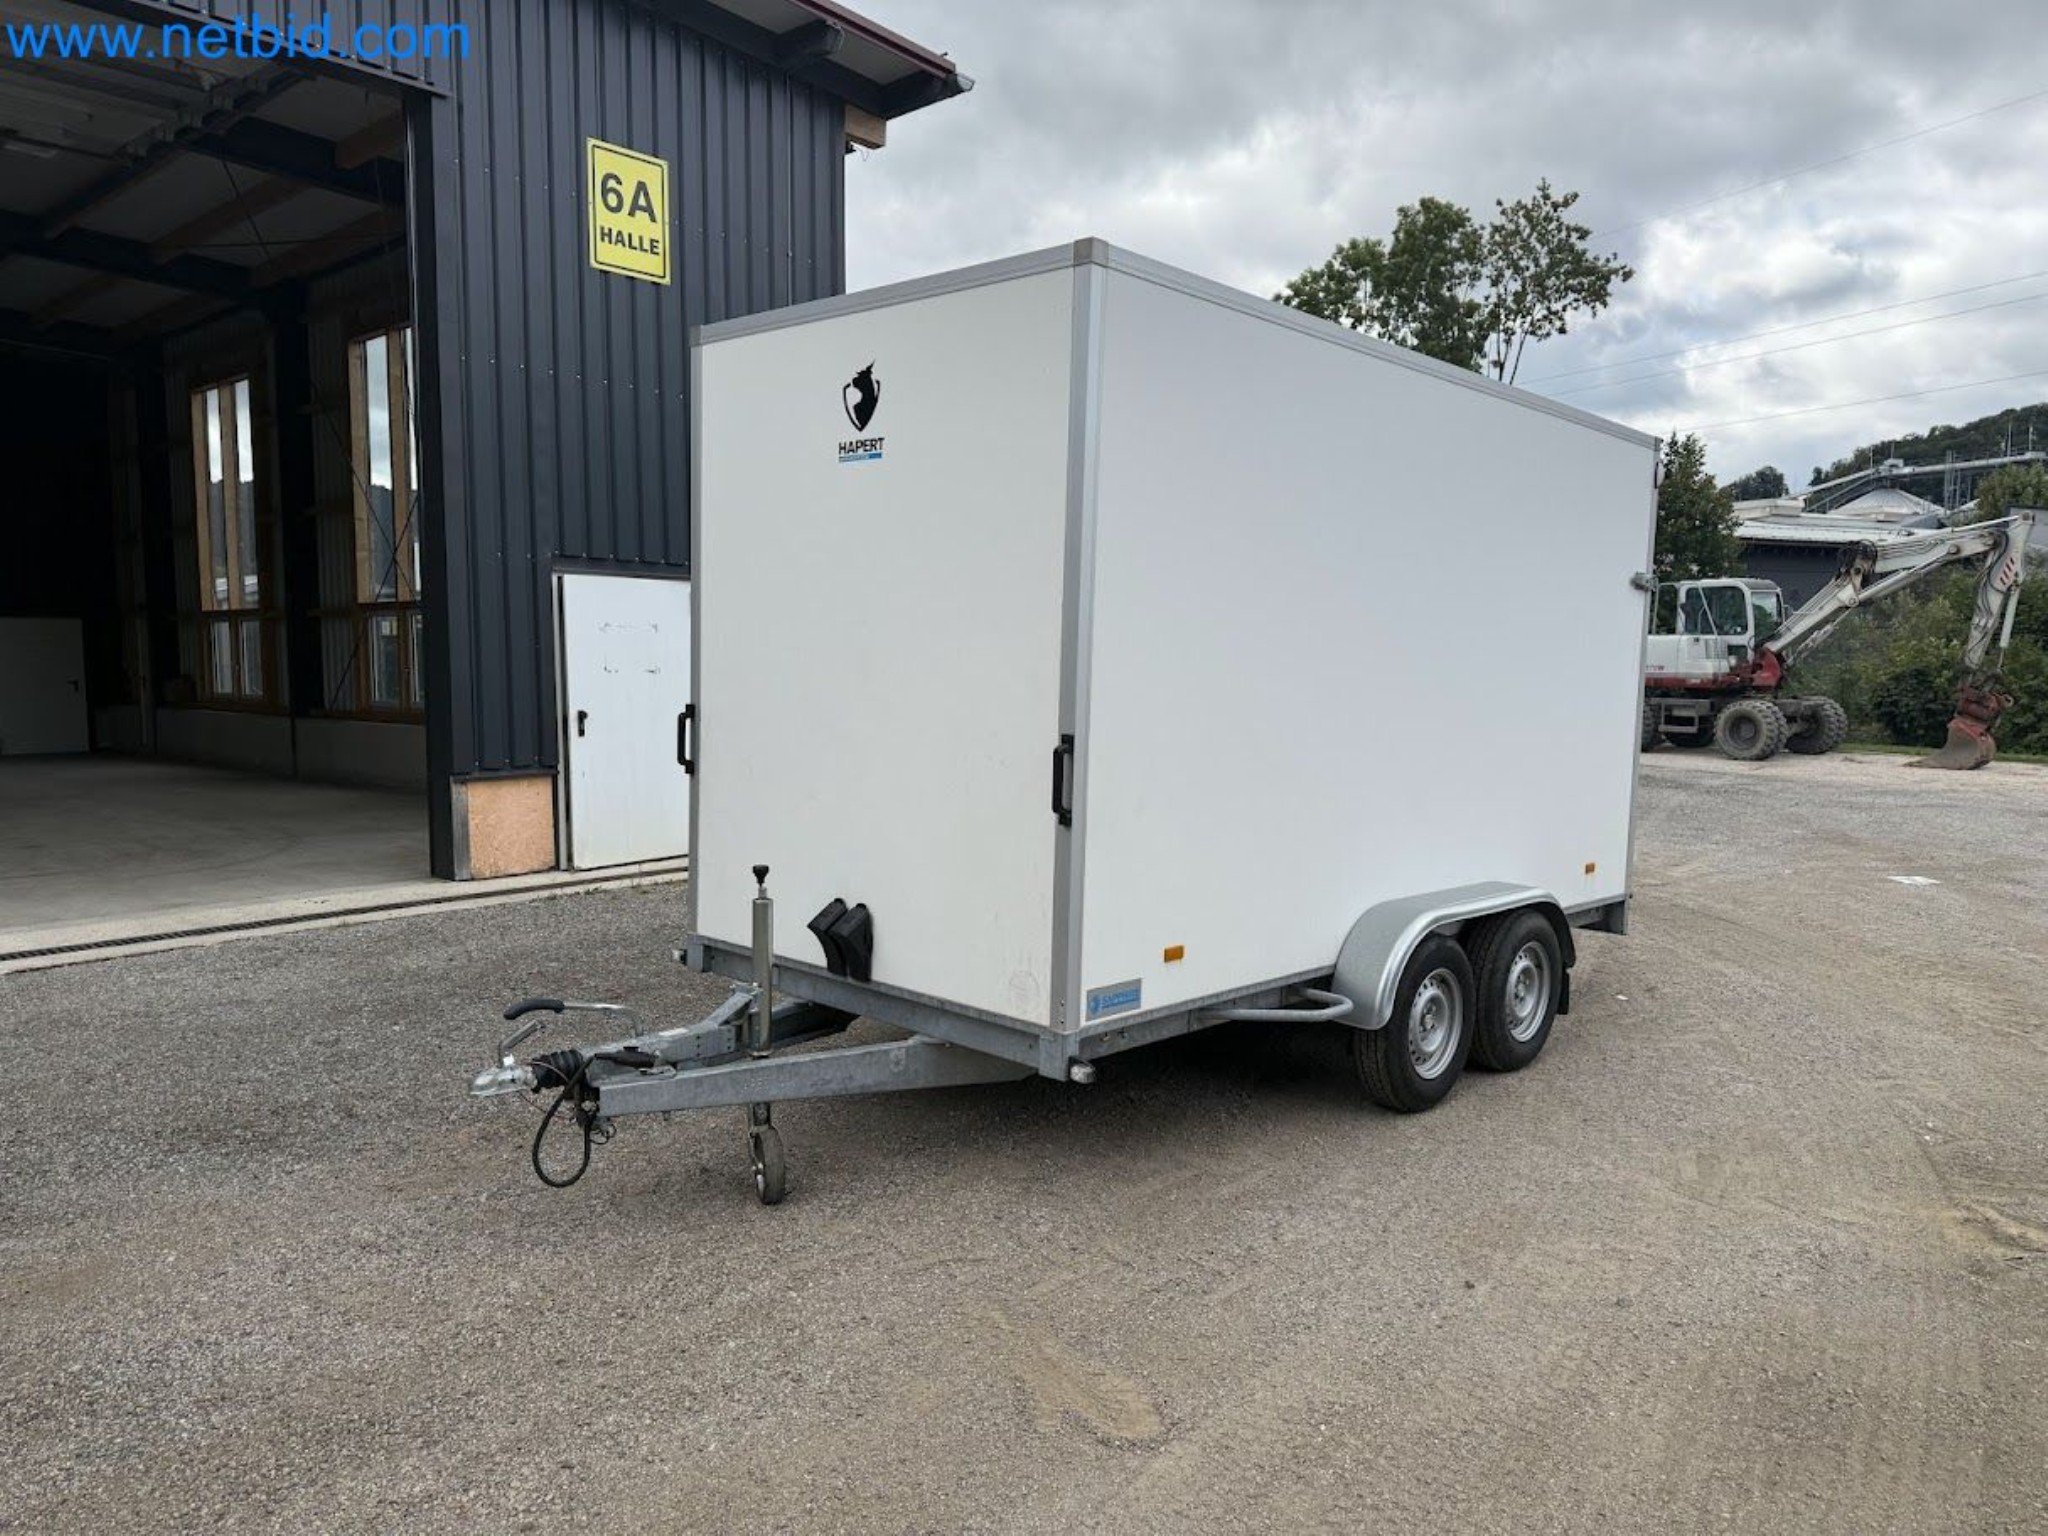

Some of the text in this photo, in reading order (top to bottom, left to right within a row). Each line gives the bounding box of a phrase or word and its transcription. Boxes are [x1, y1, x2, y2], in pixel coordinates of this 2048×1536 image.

[600, 172, 657, 223] 6A
[600, 225, 660, 256] HALLE
[838, 437, 885, 455] HAPERT
